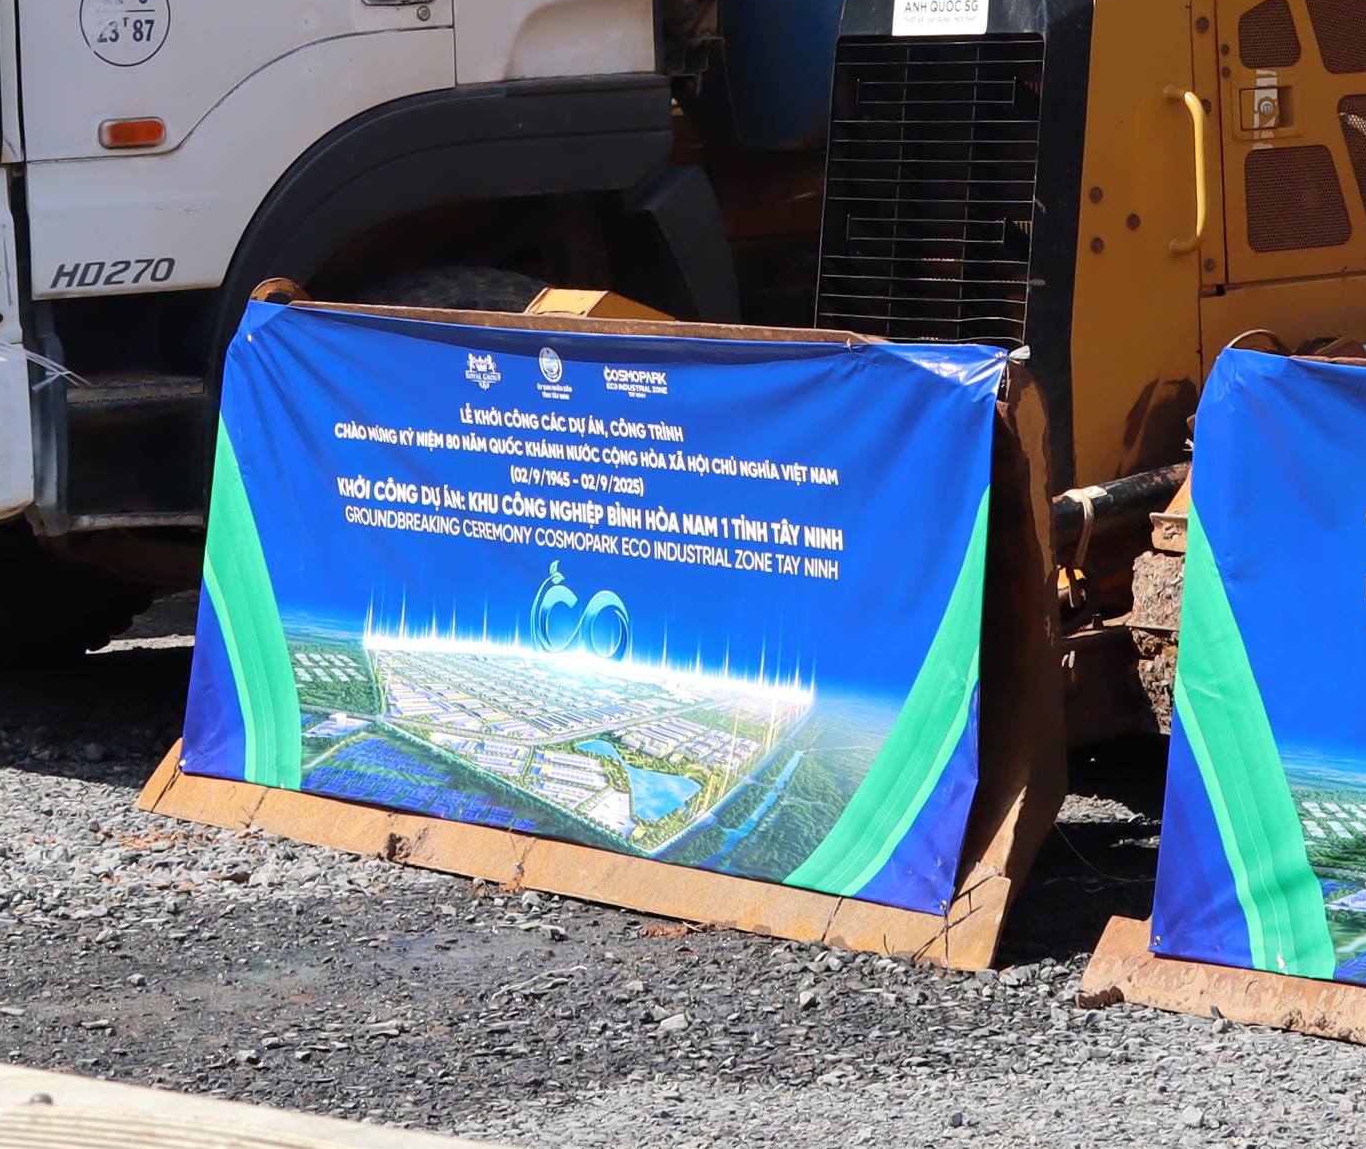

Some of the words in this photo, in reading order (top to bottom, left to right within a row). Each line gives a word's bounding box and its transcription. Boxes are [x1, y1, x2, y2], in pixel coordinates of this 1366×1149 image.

[905, 2, 927, 12] ANH
[965, 0, 979, 12] SG
[50, 258, 175, 288] HD270
[603, 366, 667, 384] COSMOPARK
[460, 403, 473, 424] LỄ
[474, 407, 502, 426] KHỞI
[504, 409, 539, 429] CÔNG
[541, 412, 566, 432] CÁC
[568, 418, 585, 437] DỰ
[588, 416, 608, 438] ÁN,
[610, 418, 646, 438] CÔNG
[648, 422, 683, 442] TRÌNH
[335, 421, 367, 439] CHÀO
[399, 428, 414, 445] KỶ
[417, 430, 443, 451] NIỆM
[446, 434, 460, 449] 80
[462, 433, 487, 452] NĂM
[489, 436, 523, 455] QUỐC
[525, 439, 564, 459] KHÁNH
[566, 444, 600, 462] NƯỚC
[603, 447, 638, 468] CỘNG
[641, 448, 667, 469] HÒA
[669, 451, 686, 470] XÃ
[688, 454, 709, 476] HỘI
[712, 456, 737, 475] CHỦ
[740, 460, 779, 480] NGHĨA
[781, 463, 807, 485] VIỆT
[811, 467, 838, 485] NAM
[511, 465, 570, 487] (02/9/1945
[581, 474, 643, 496] 02/9/2025)
[337, 475, 370, 499] KHỞI
[374, 478, 418, 504] CÔNG
[421, 486, 441, 511] DỰ
[444, 485, 465, 510] ÁN:
[469, 492, 498, 514] KHU
[502, 492, 546, 518] CÔNG
[550, 500, 603, 528] NGHIỆP
[607, 502, 641, 528] BÌNH
[645, 506, 679, 532] HÒA
[683, 514, 717, 537] NAM
[721, 518, 728, 538] 1
[731, 514, 767, 542] TỈNH
[771, 519, 799, 545] TÂY
[804, 526, 843, 550] NINH
[346, 506, 460, 535] GROUNDBREAKING
[463, 520, 531, 544] CEREMONY
[535, 528, 618, 554] COSMOPARK
[622, 538, 651, 557] ECO
[654, 541, 731, 567] INDUSTRIAL
[735, 550, 771, 572] ZONE
[777, 554, 800, 574] TAY
[805, 558, 837, 579] NINH
